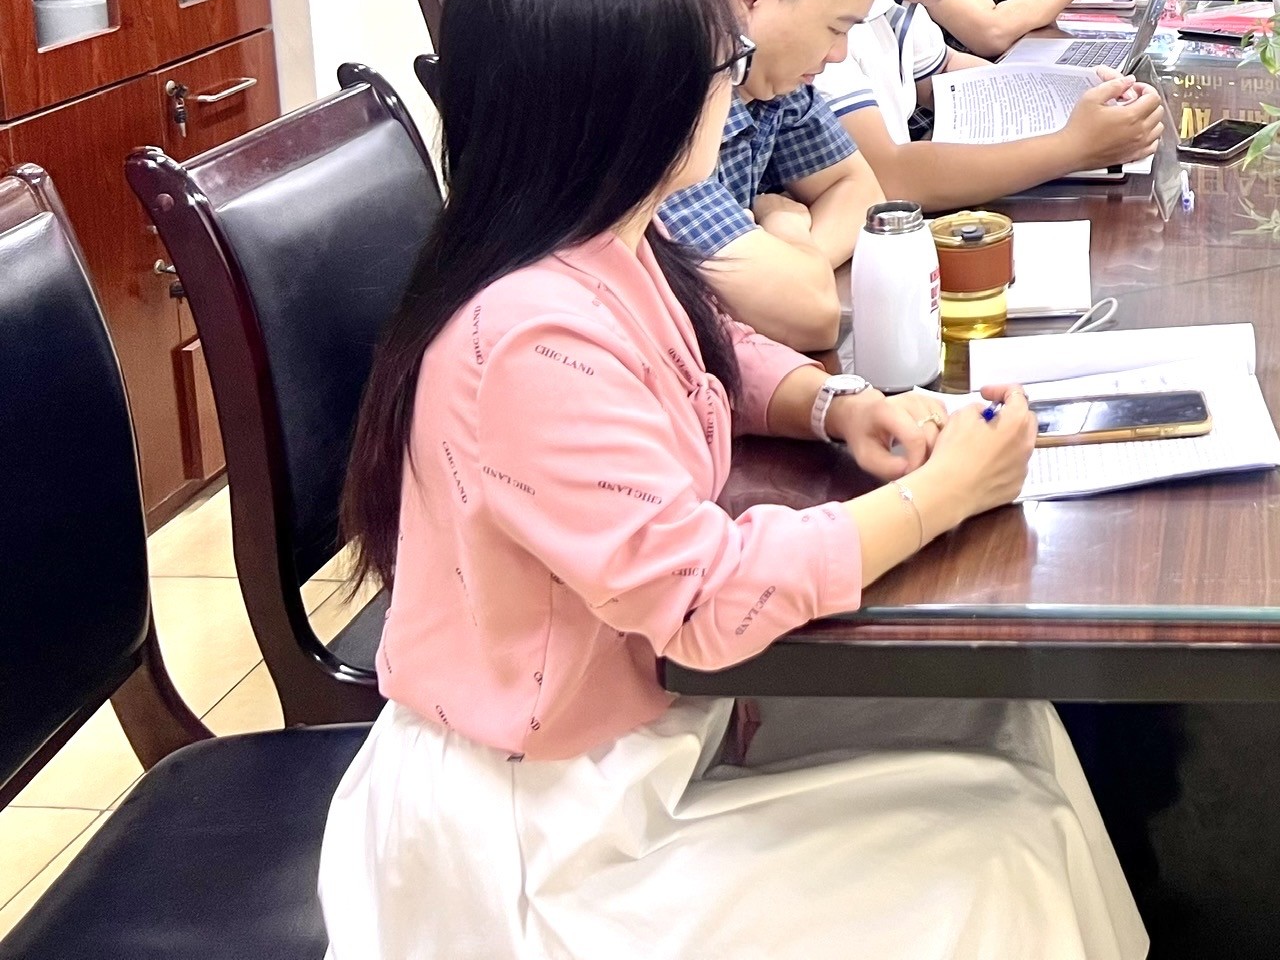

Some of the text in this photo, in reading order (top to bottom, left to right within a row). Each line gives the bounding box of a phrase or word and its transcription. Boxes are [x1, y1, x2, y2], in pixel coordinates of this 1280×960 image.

[534, 344, 594, 377] CHIC LAND
[482, 465, 536, 496] CHIC LAND
[597, 480, 663, 505] CHIC LAND
